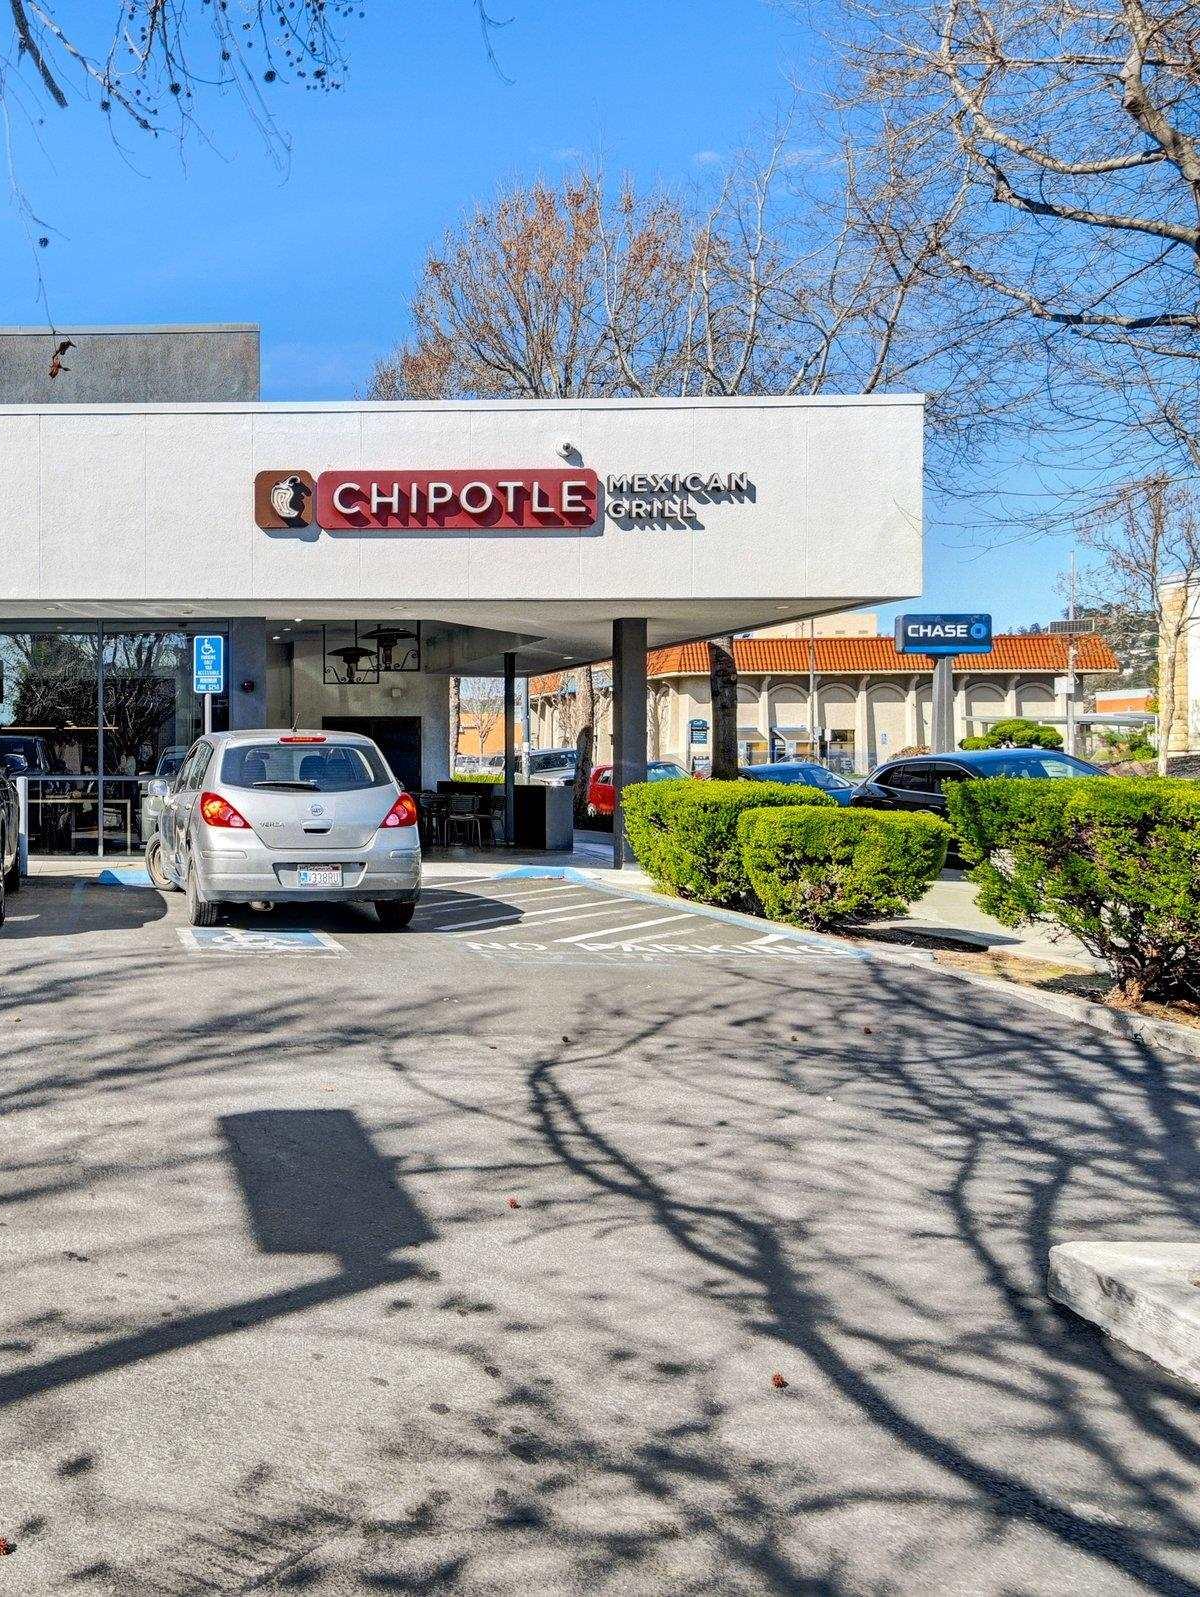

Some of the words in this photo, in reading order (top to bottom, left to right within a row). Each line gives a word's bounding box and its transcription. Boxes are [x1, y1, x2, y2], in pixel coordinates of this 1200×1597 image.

[607, 472, 748, 493] MEXICAN
[332, 480, 588, 515] CHIPOTLE
[606, 499, 696, 518] GRILL
[907, 624, 969, 637] CHASE
[465, 941, 548, 951] NO
[573, 943, 852, 954] PARKING
